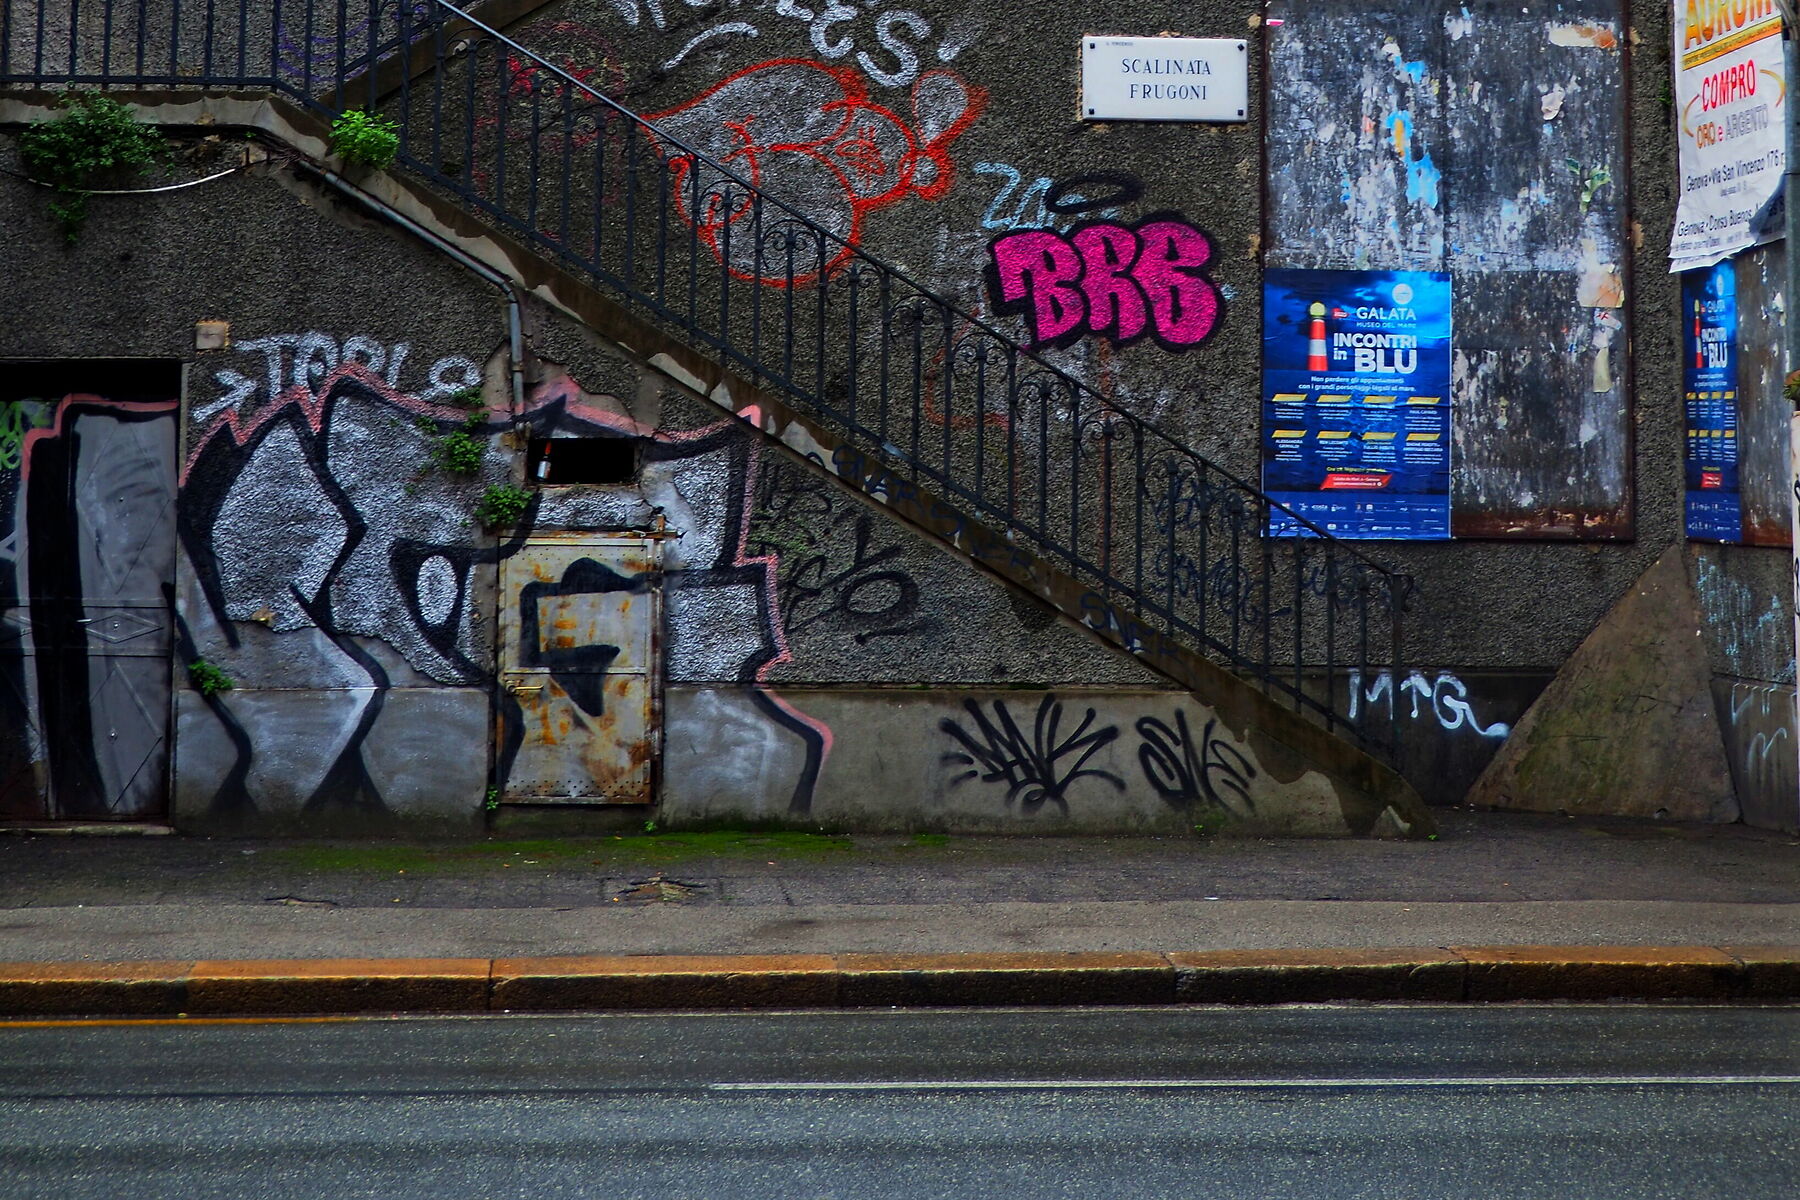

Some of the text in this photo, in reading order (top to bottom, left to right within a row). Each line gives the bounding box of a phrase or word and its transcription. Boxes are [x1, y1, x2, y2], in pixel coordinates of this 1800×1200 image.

[1121, 58, 1211, 75] SCALINATA
[1130, 84, 1206, 100] FRUGONI
[1702, 59, 1755, 112] COMPRO
[1696, 103, 1769, 149] ORO e ARGENTO
[1723, 164, 1734, 181] San
[1356, 306, 1417, 320] GALATA
[1333, 332, 1417, 348] INCONTRI
[1333, 347, 1418, 374] in BLU
[1708, 342, 1728, 368] BLU
